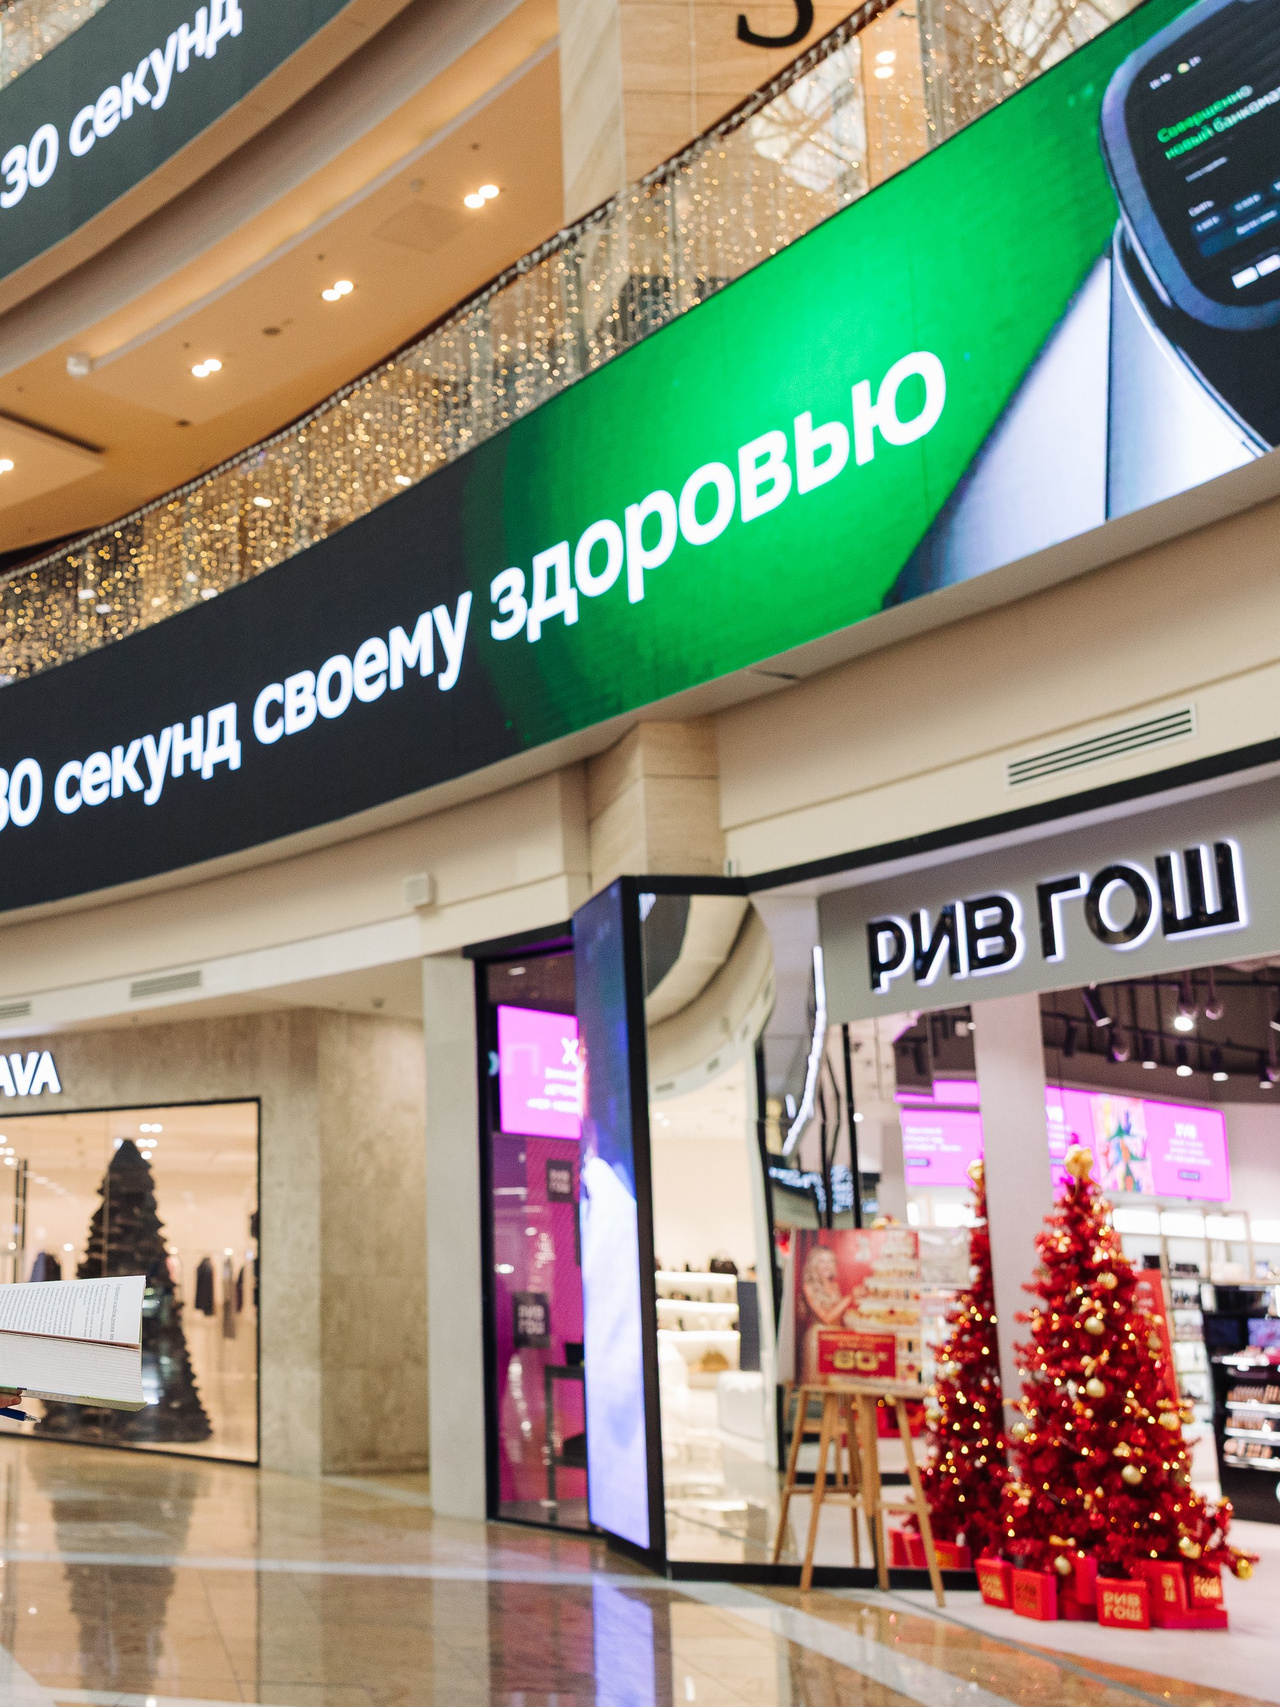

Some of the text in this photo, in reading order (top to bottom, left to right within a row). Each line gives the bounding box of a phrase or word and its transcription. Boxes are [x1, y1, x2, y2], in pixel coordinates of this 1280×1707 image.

[0, 123, 59, 209] 30
[68, 0, 243, 157] секунд
[54, 702, 241, 806] секунд
[253, 591, 472, 744] своему
[490, 350, 947, 642] здоровью
[866, 838, 1248, 993] РИВ ГОШ
